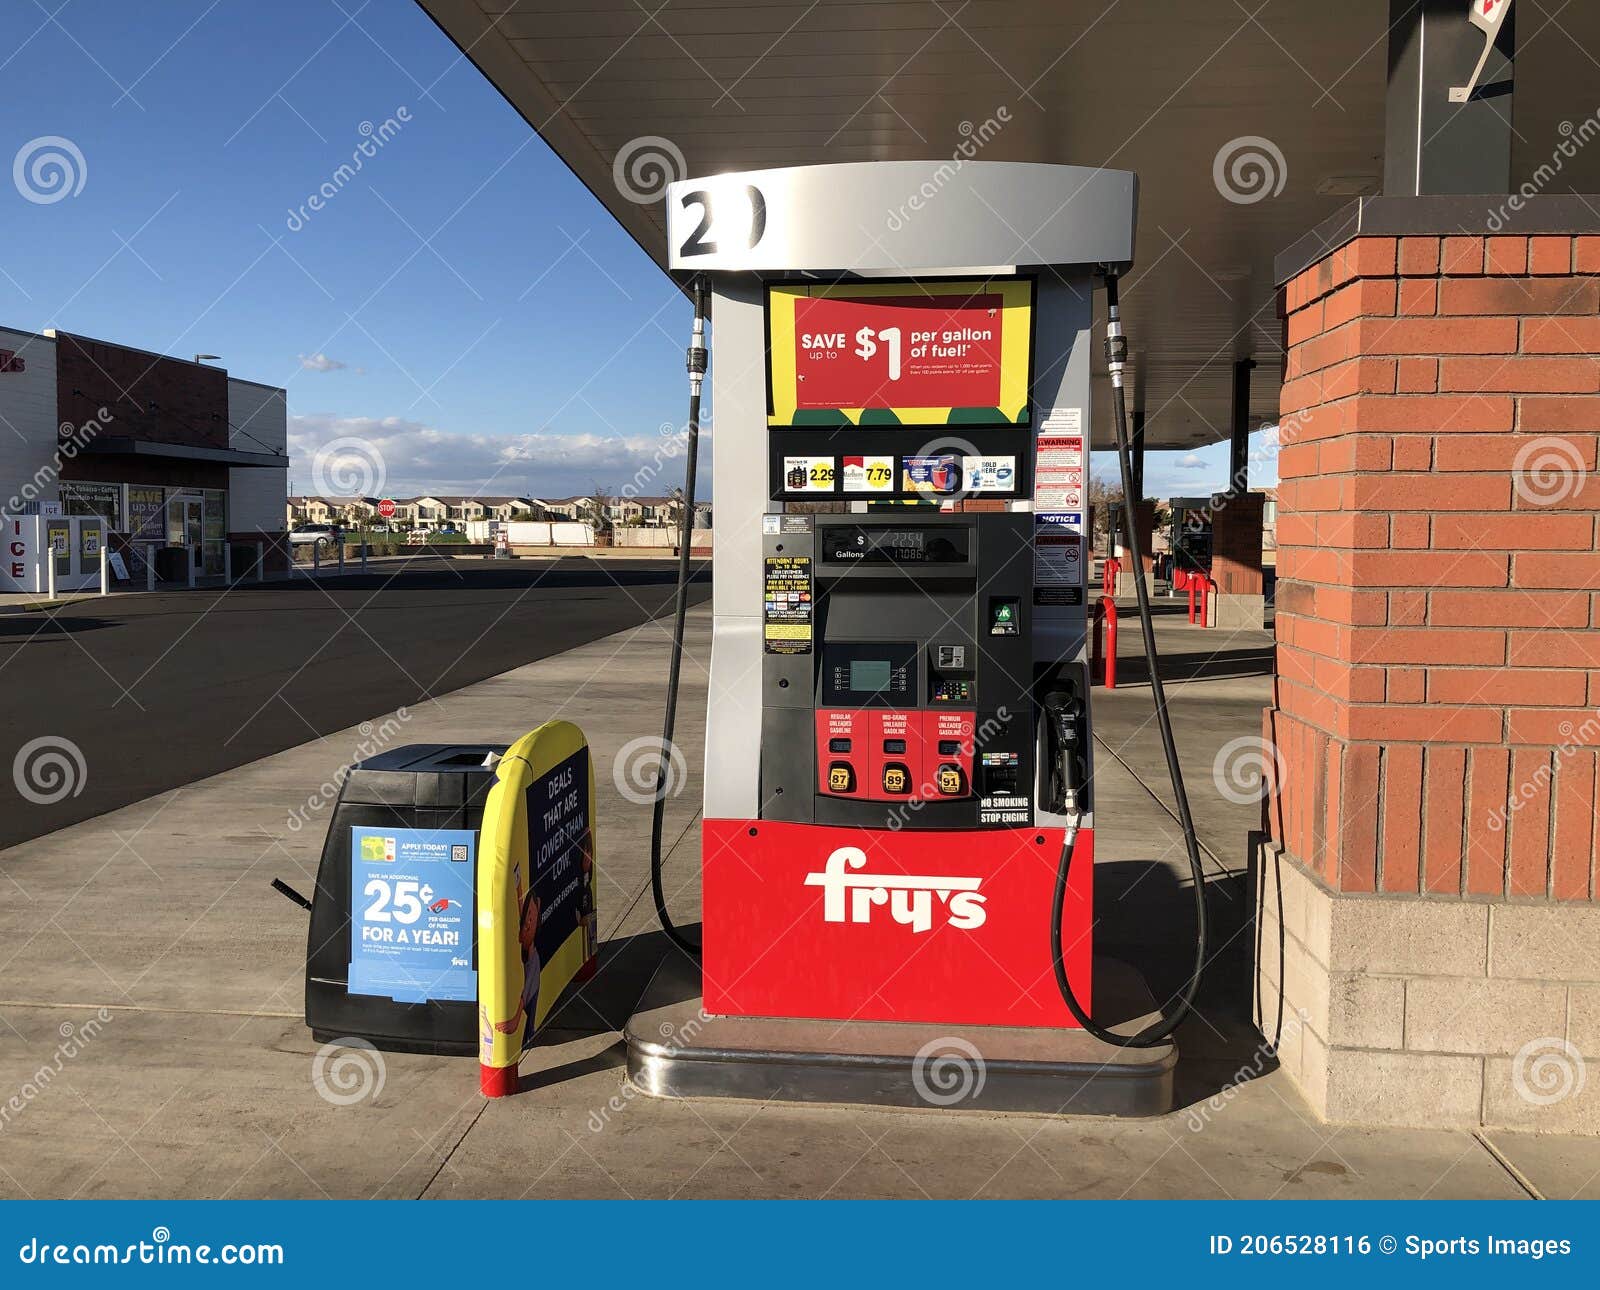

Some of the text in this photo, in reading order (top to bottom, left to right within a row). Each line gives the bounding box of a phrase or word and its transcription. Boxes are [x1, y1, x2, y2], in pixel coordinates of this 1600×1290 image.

[802, 333, 846, 349] SAVE
[911, 328, 992, 344] per gallon
[809, 350, 838, 360] up to
[855, 326, 901, 381] $1
[911, 344, 928, 358] of
[810, 468, 835, 480] 2.29
[866, 468, 892, 480] 7.79
[133, 502, 158, 512] up to
[857, 536, 864, 546] $
[11, 520, 25, 577] ICE
[548, 767, 572, 800] DEALS
[832, 774, 846, 784] 87
[887, 776, 902, 785] 89
[943, 777, 957, 786] 91
[981, 797, 1028, 808] NO SMOKING
[544, 789, 578, 832] THAT ARE
[981, 812, 1028, 823] STOP ENGINE
[537, 811, 584, 869] LOWER THAN
[804, 846, 987, 933] fry's
[362, 926, 459, 945] FOR A YEAR!
